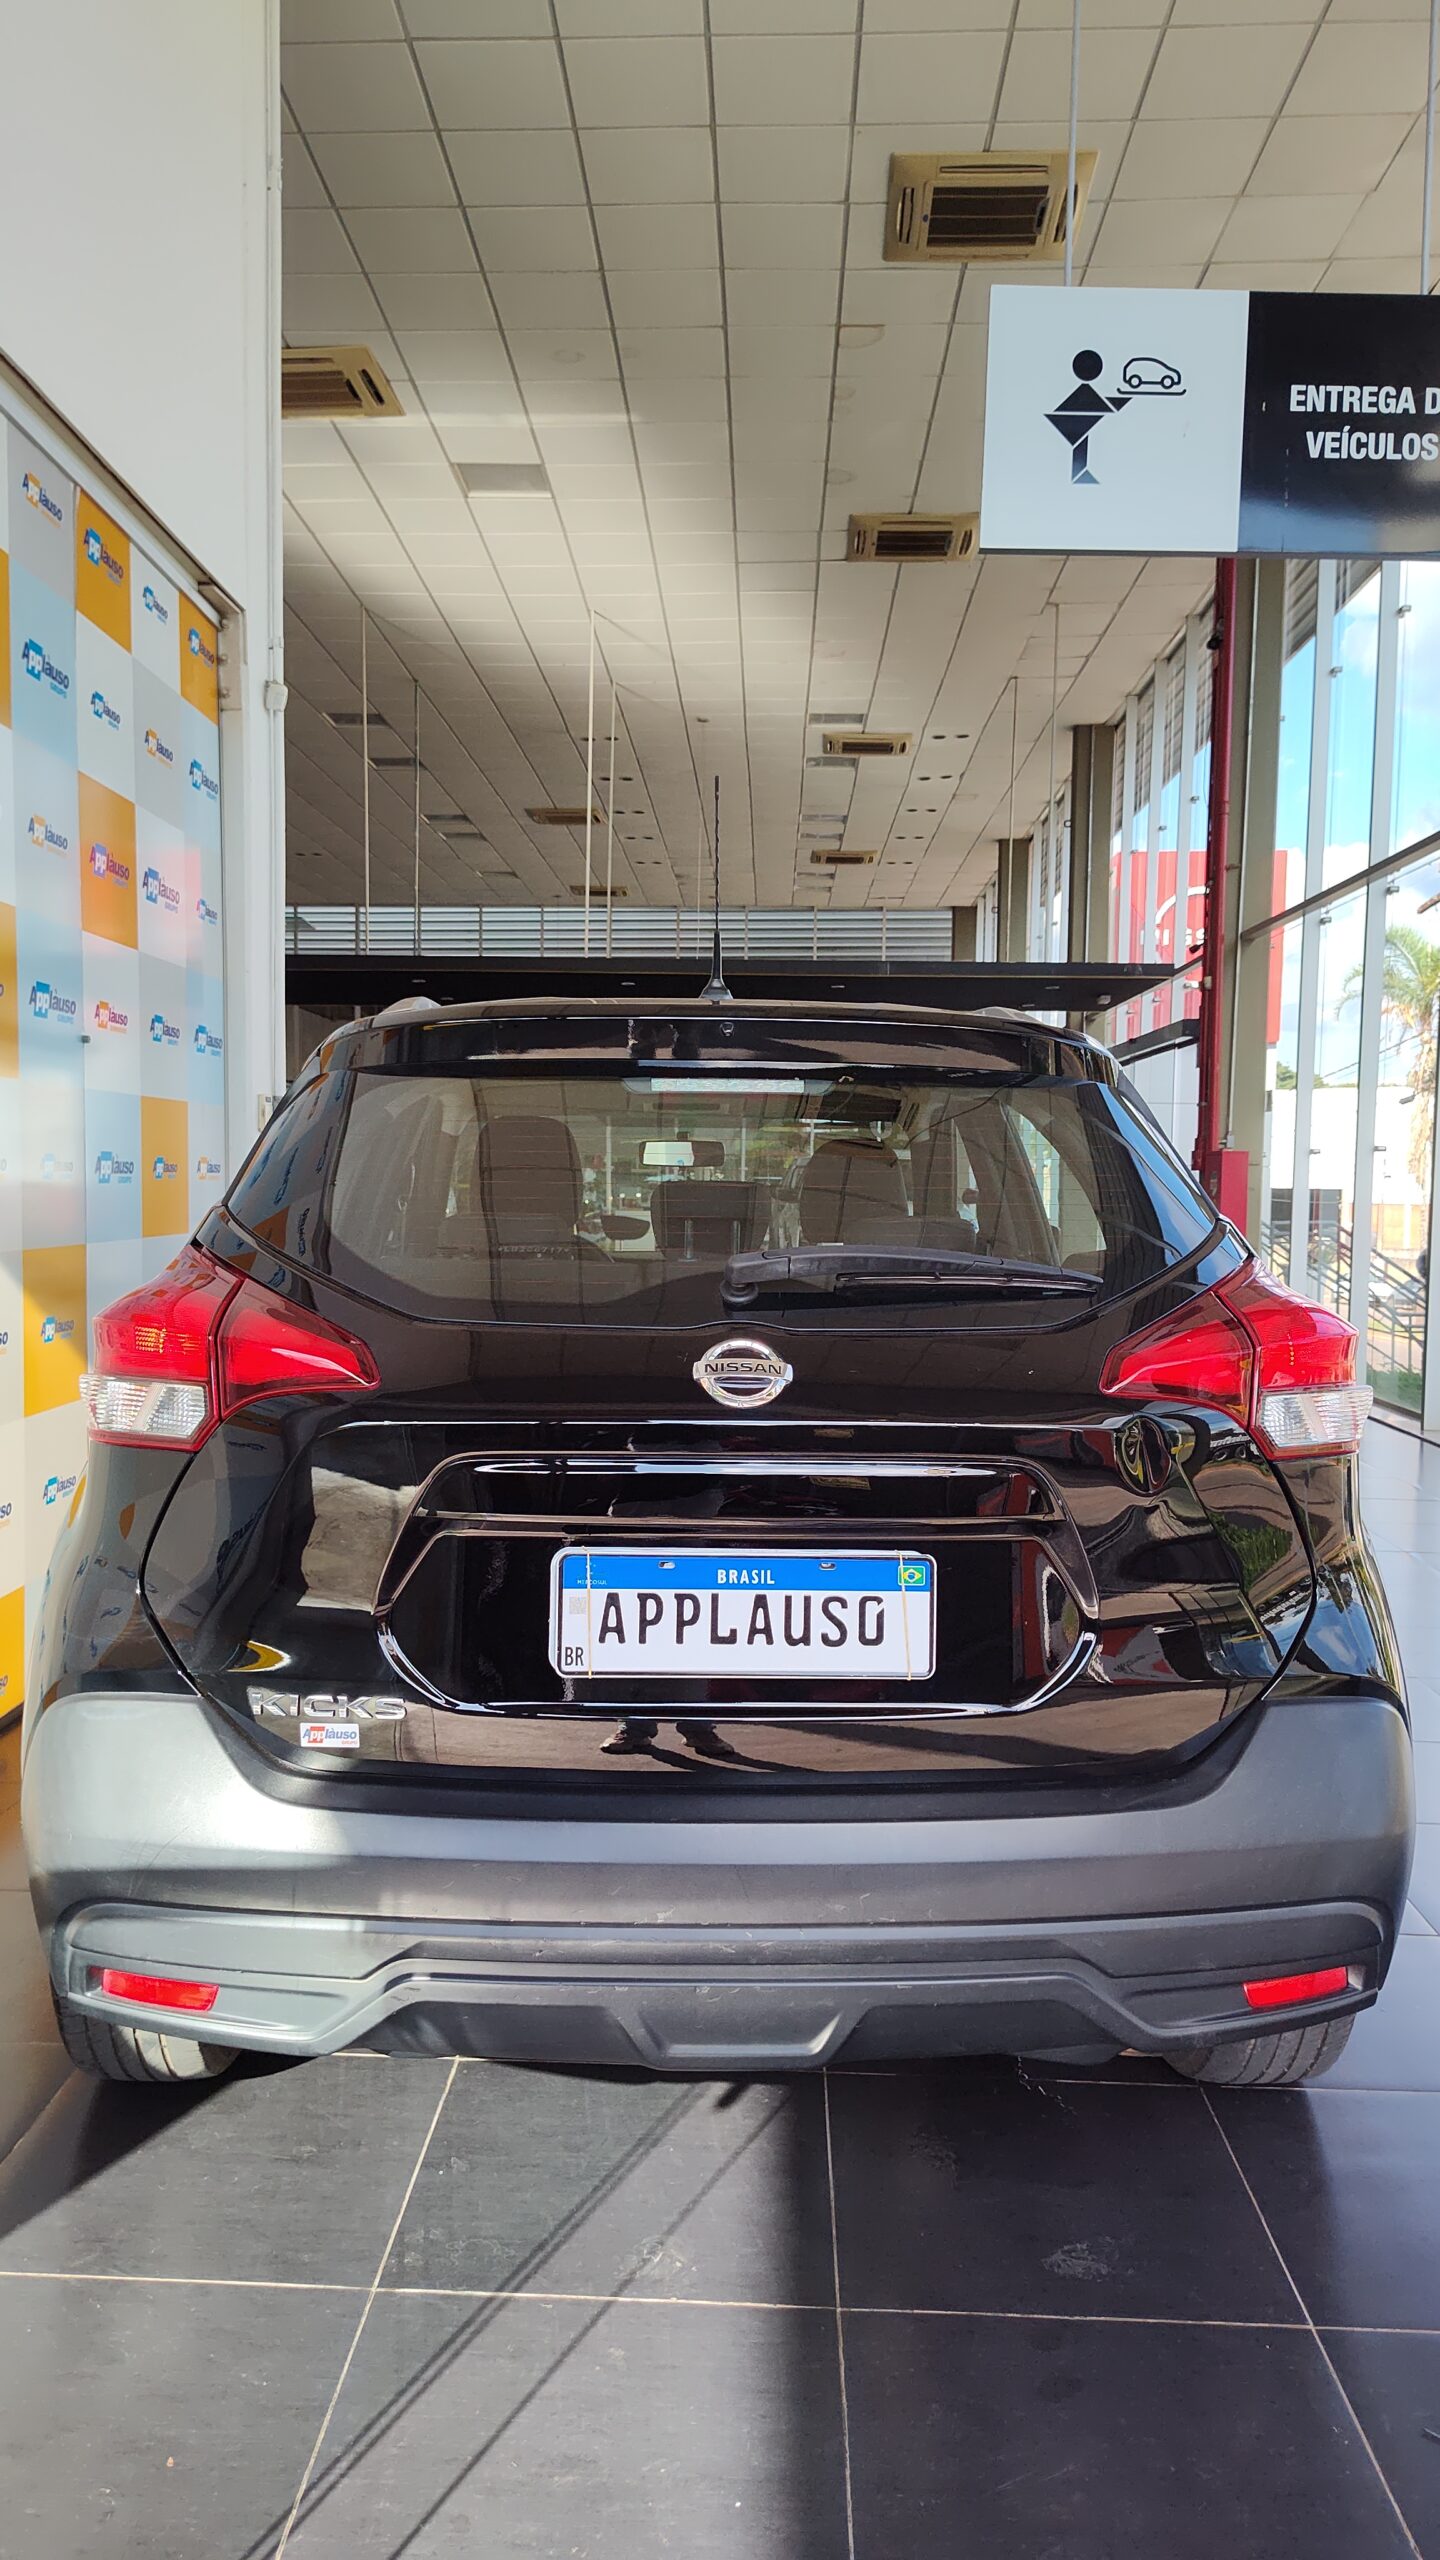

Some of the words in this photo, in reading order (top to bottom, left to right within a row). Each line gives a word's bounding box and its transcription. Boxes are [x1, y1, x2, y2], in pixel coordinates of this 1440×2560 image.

[1290, 384, 1416, 415] ENTREGA
[1305, 425, 1439, 461] VEÍCULOS
[704, 1362, 782, 1375] NISSAN
[717, 1568, 775, 1585] BRASIL
[598, 1592, 886, 1648] APPLAUSO
[564, 1646, 584, 1666] BR
[251, 1692, 408, 1721] KICKS
